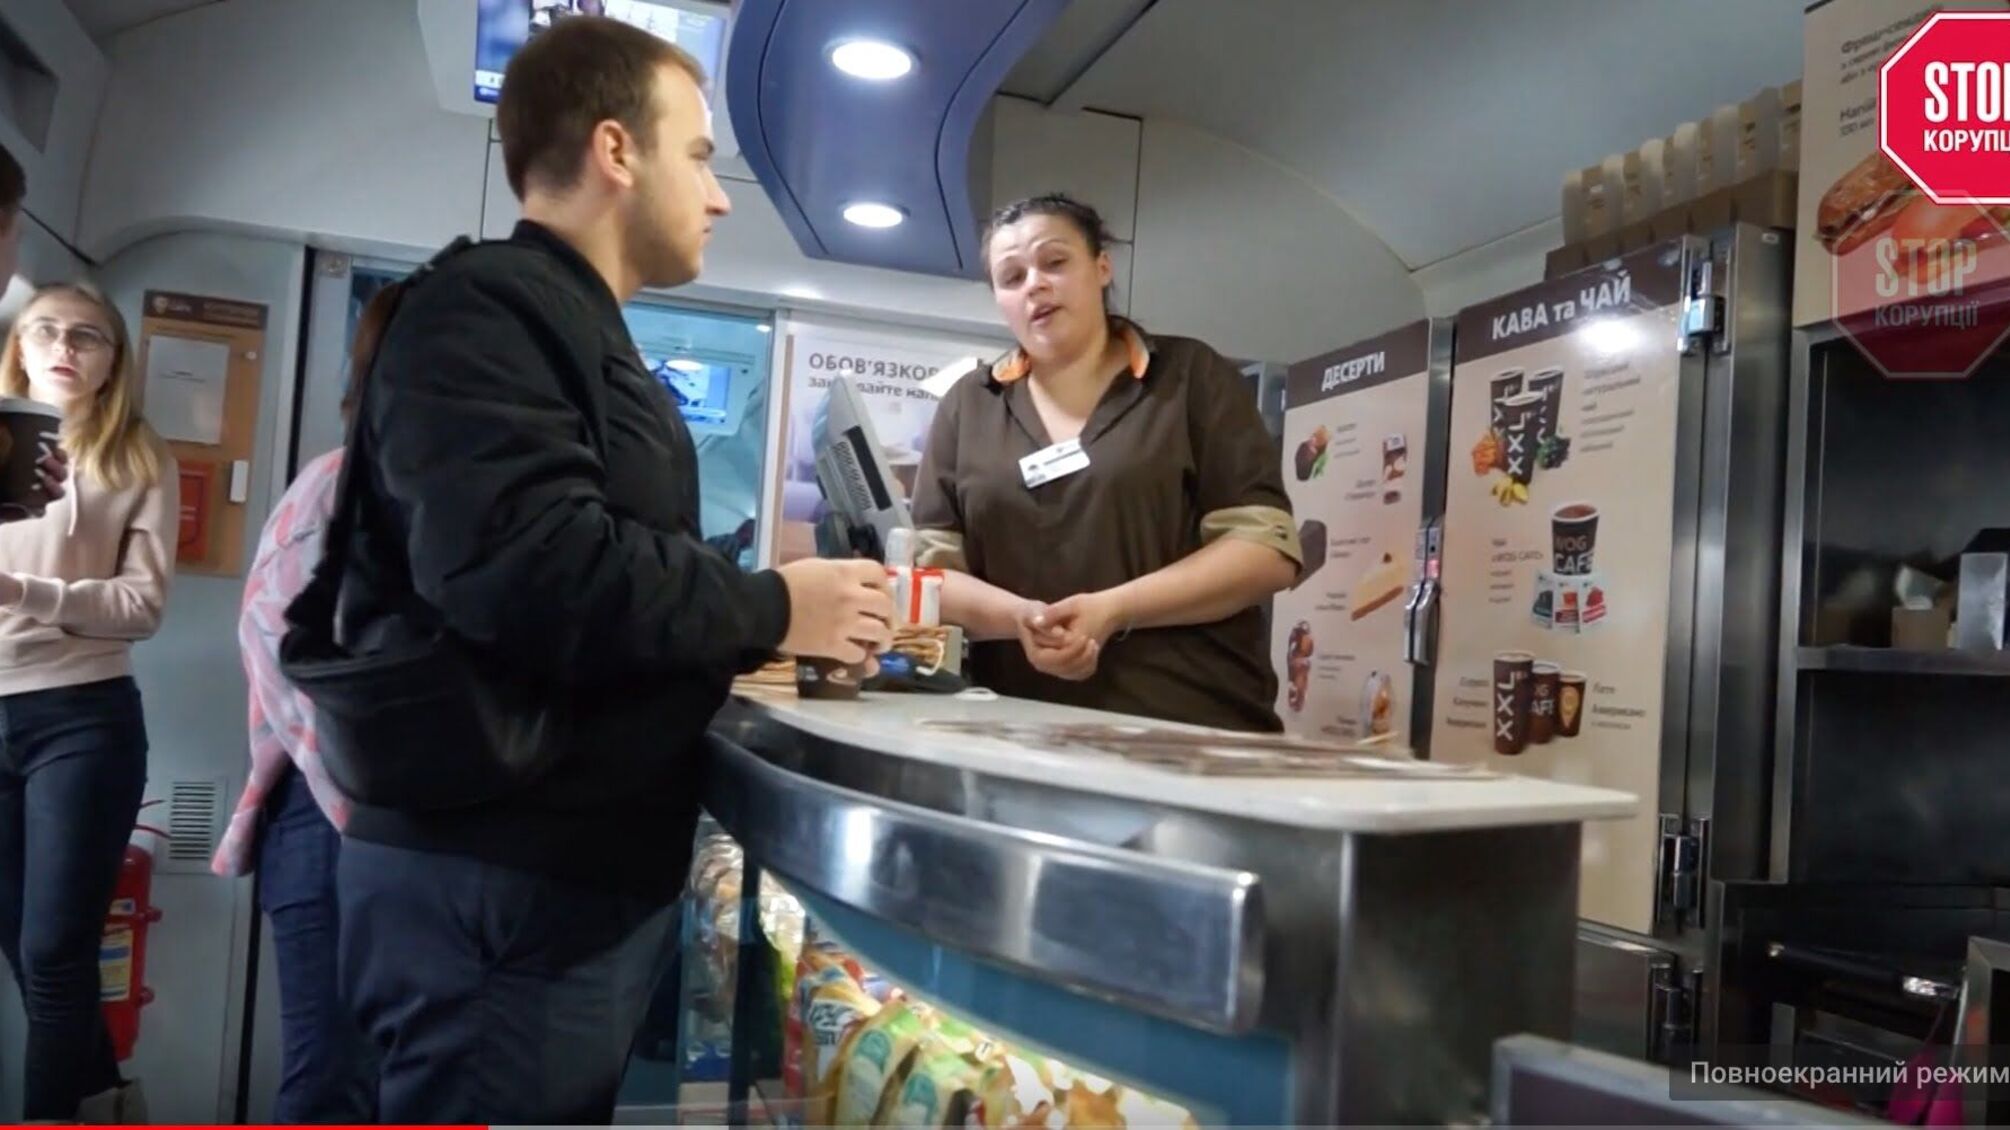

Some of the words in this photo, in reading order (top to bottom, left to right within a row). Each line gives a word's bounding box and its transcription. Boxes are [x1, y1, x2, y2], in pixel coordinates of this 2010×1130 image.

[1492, 303, 1547, 340] КАВА
[1553, 300, 1575, 322] та
[1580, 270, 1631, 312] ЧАЙ
[1321, 351, 1386, 392] ДЕСЕРТИ
